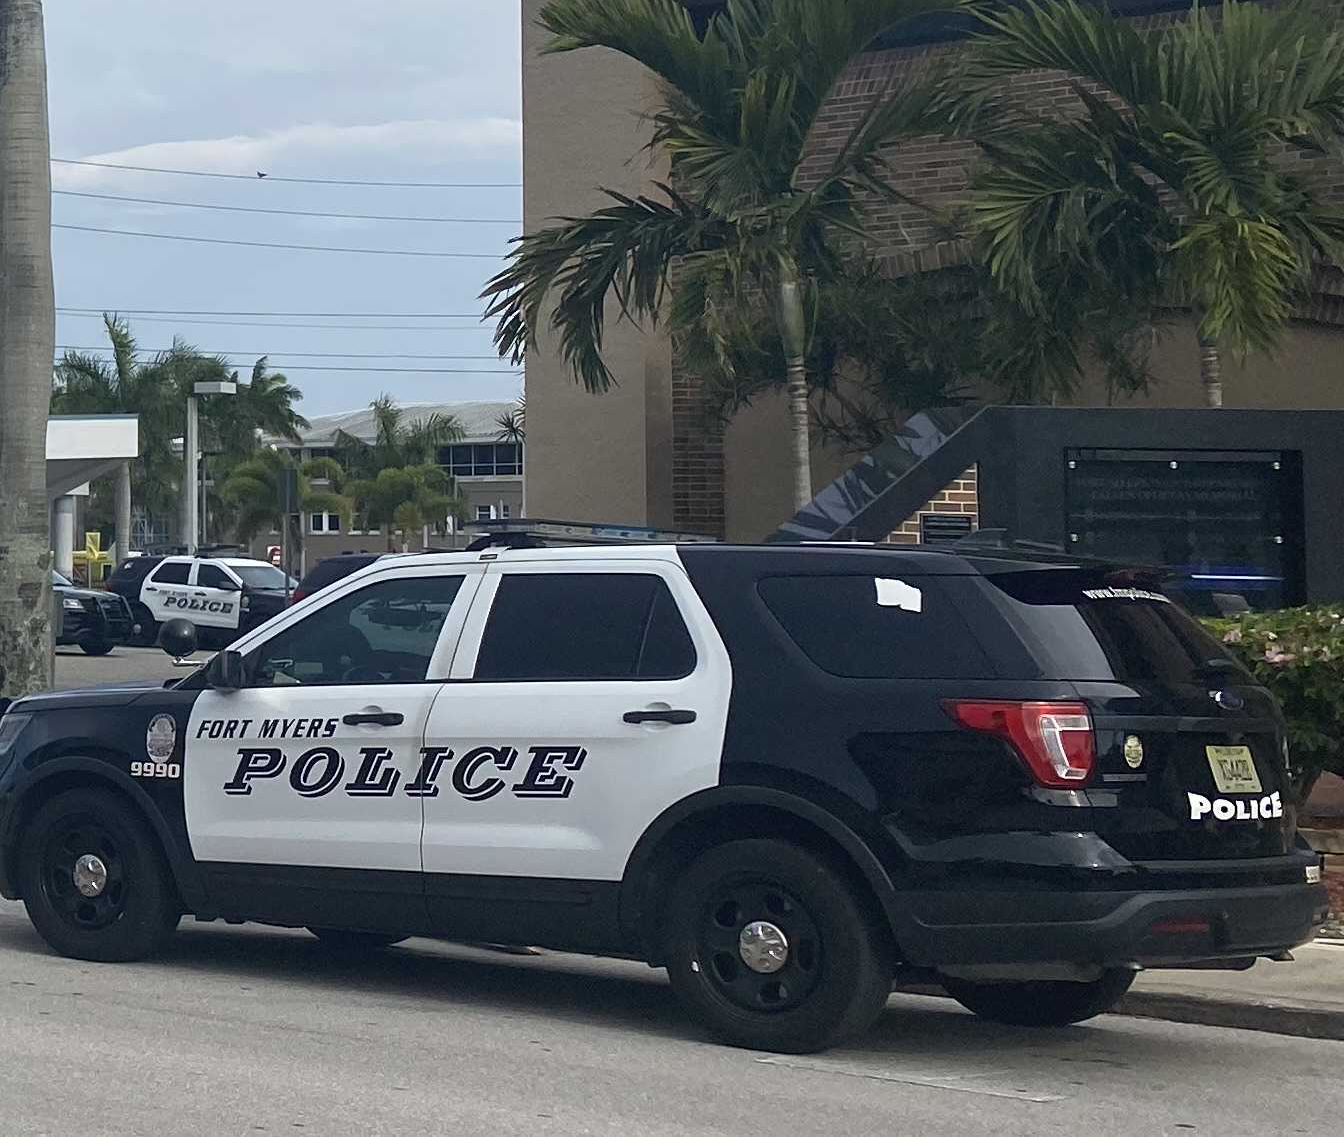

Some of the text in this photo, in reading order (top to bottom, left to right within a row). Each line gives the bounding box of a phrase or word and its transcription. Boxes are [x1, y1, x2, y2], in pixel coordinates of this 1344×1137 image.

[163, 596, 234, 614] POLICE
[196, 719, 254, 739] FORT
[258, 718, 340, 739] MYERS
[130, 761, 180, 778] 9990
[223, 746, 588, 802] POLICE
[1187, 791, 1283, 820] POLICE
